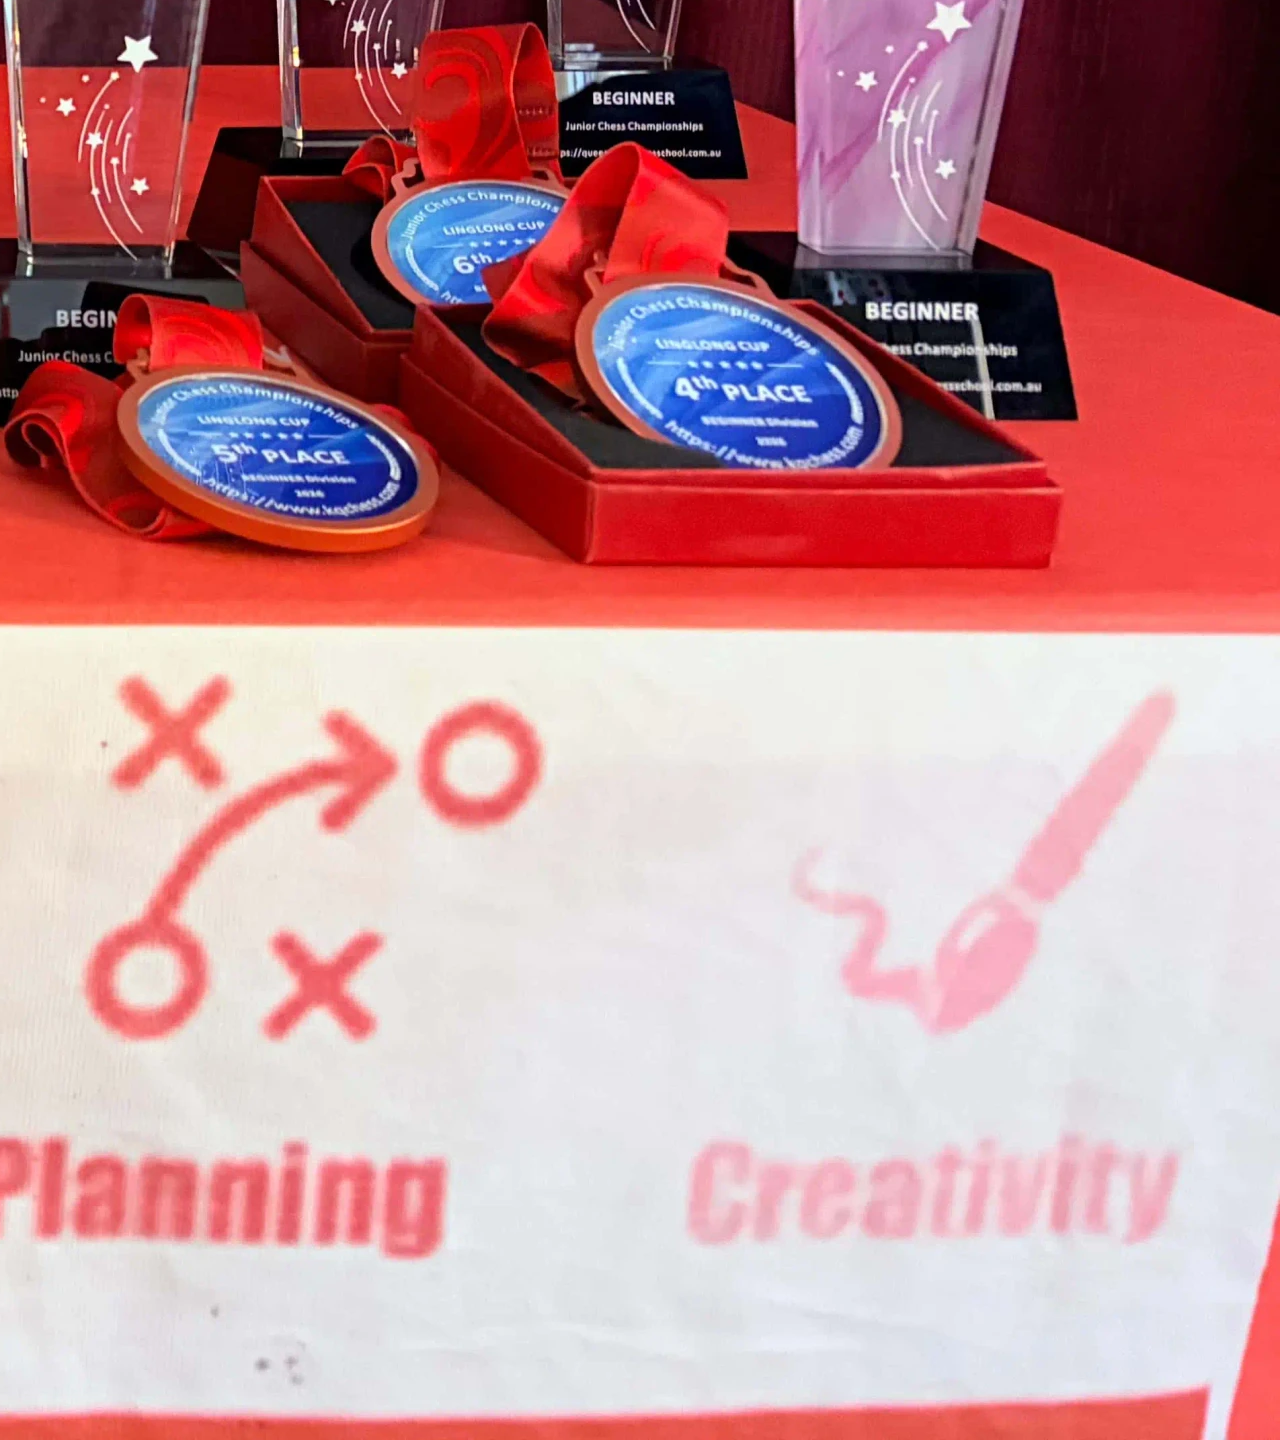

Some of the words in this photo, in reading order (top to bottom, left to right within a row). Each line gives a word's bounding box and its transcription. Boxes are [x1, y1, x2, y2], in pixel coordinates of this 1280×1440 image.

[593, 92, 675, 105] BEGINNER
[566, 122, 595, 131] Junior
[598, 122, 625, 131] Chess
[628, 122, 703, 132] Championships
[442, 221, 516, 236] LINGLONG
[517, 221, 546, 232] CUP
[452, 253, 493, 275] 6th
[865, 302, 979, 320] BEGINNER
[678, 296, 820, 357] Championships
[656, 338, 737, 351] LINGLONG
[739, 341, 770, 352] CUP
[914, 343, 1018, 358] Championships
[18, 350, 60, 361] Junior
[63, 351, 101, 363] Chess
[675, 376, 718, 401] 4th
[724, 385, 812, 403] PLACE
[219, 383, 359, 430] Championships
[198, 415, 277, 426] LINGLONG
[279, 417, 310, 427] CUP
[213, 444, 258, 463] 5th
[265, 450, 351, 465] PLACE
[686, 1135, 1179, 1246] Creativity
